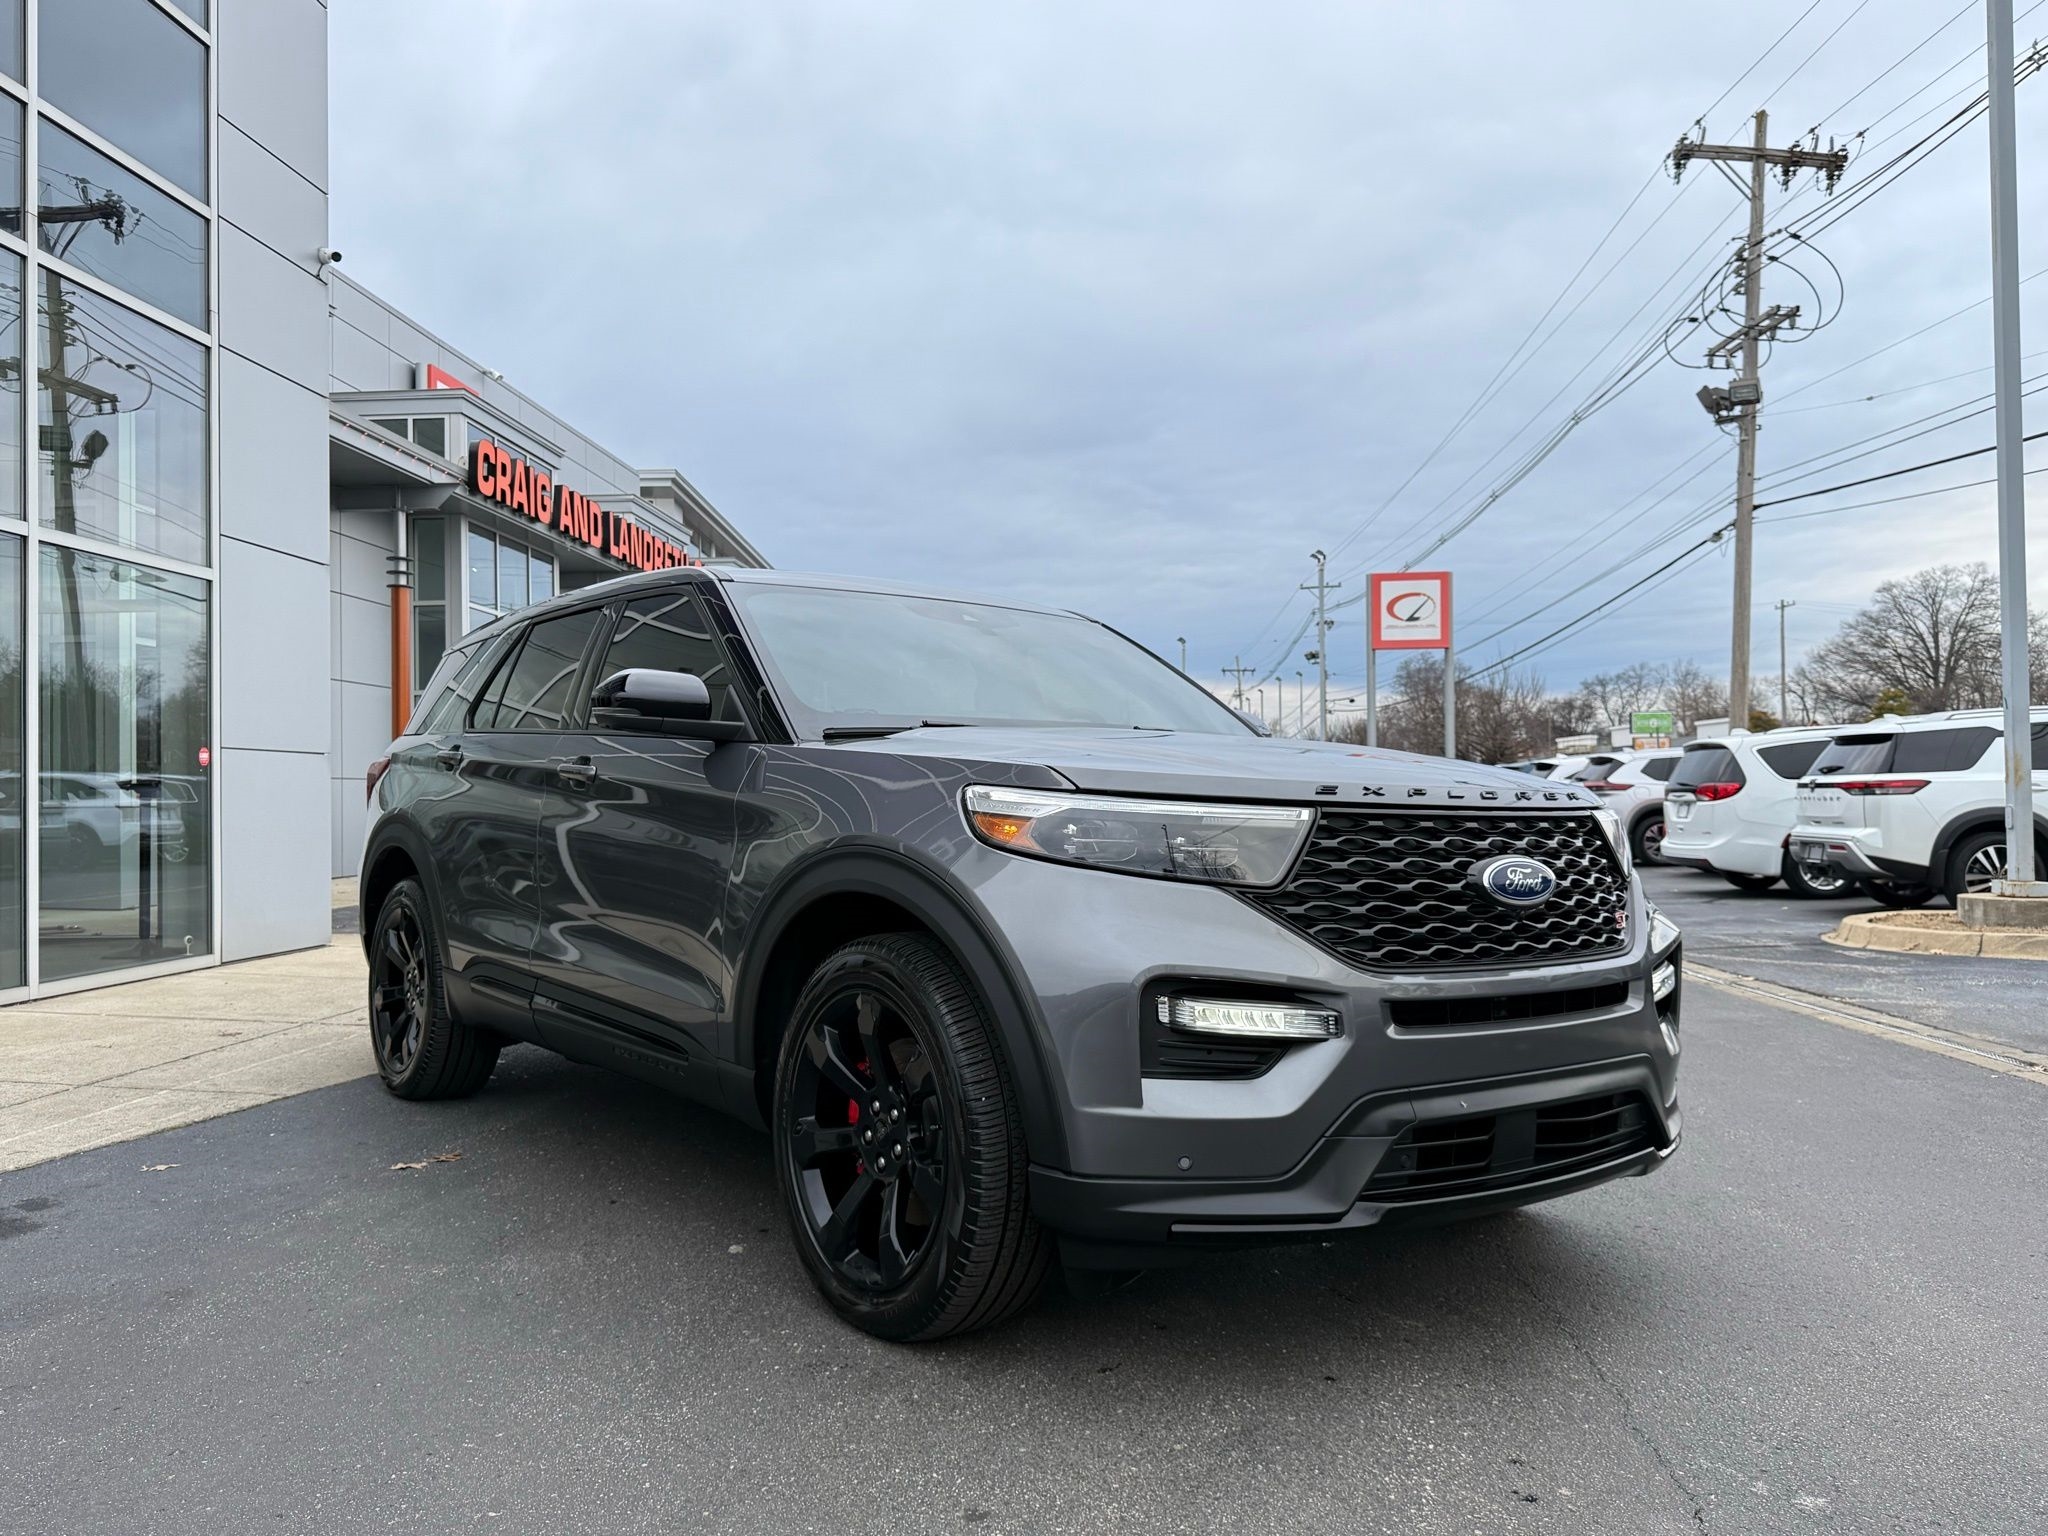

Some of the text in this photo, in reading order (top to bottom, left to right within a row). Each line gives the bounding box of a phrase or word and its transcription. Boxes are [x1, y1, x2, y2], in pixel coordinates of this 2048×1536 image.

[475, 437, 552, 525] CRAIG
[558, 484, 604, 549] AND
[1314, 784, 1582, 802] EXPLORER
[1505, 866, 1545, 893] Ford
